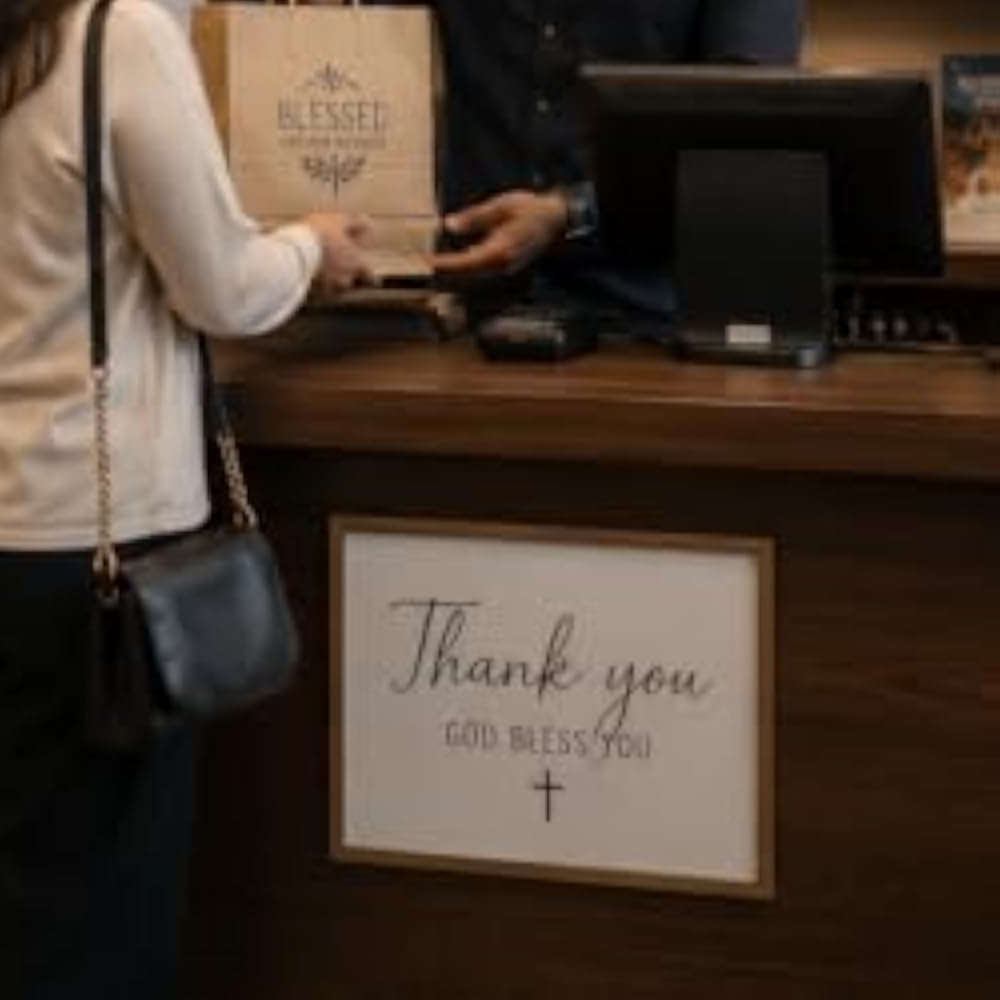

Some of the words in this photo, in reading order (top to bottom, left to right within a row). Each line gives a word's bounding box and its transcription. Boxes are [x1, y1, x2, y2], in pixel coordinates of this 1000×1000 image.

[277, 98, 389, 132] BLESSED
[388, 598, 582, 702] Thank
[594, 660, 714, 738] you
[445, 720, 498, 752] GOD
[509, 725, 588, 757] BLESS
[599, 730, 652, 761] YOU
